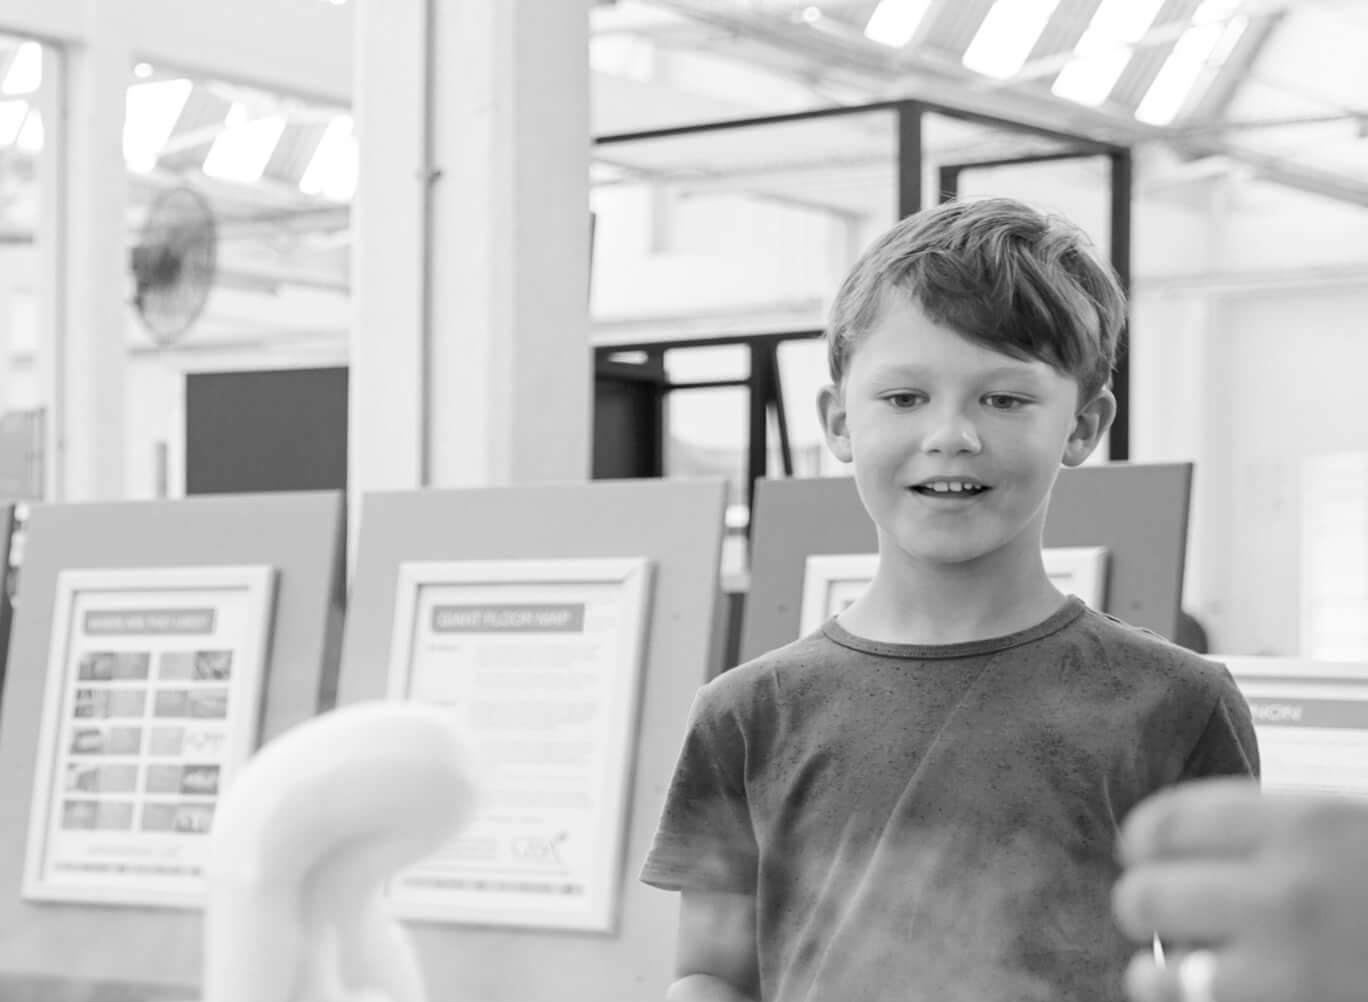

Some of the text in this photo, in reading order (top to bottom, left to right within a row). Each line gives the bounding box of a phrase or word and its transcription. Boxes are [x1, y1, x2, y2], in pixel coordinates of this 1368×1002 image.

[438, 608, 572, 627] GIANT FLOOR MAP
